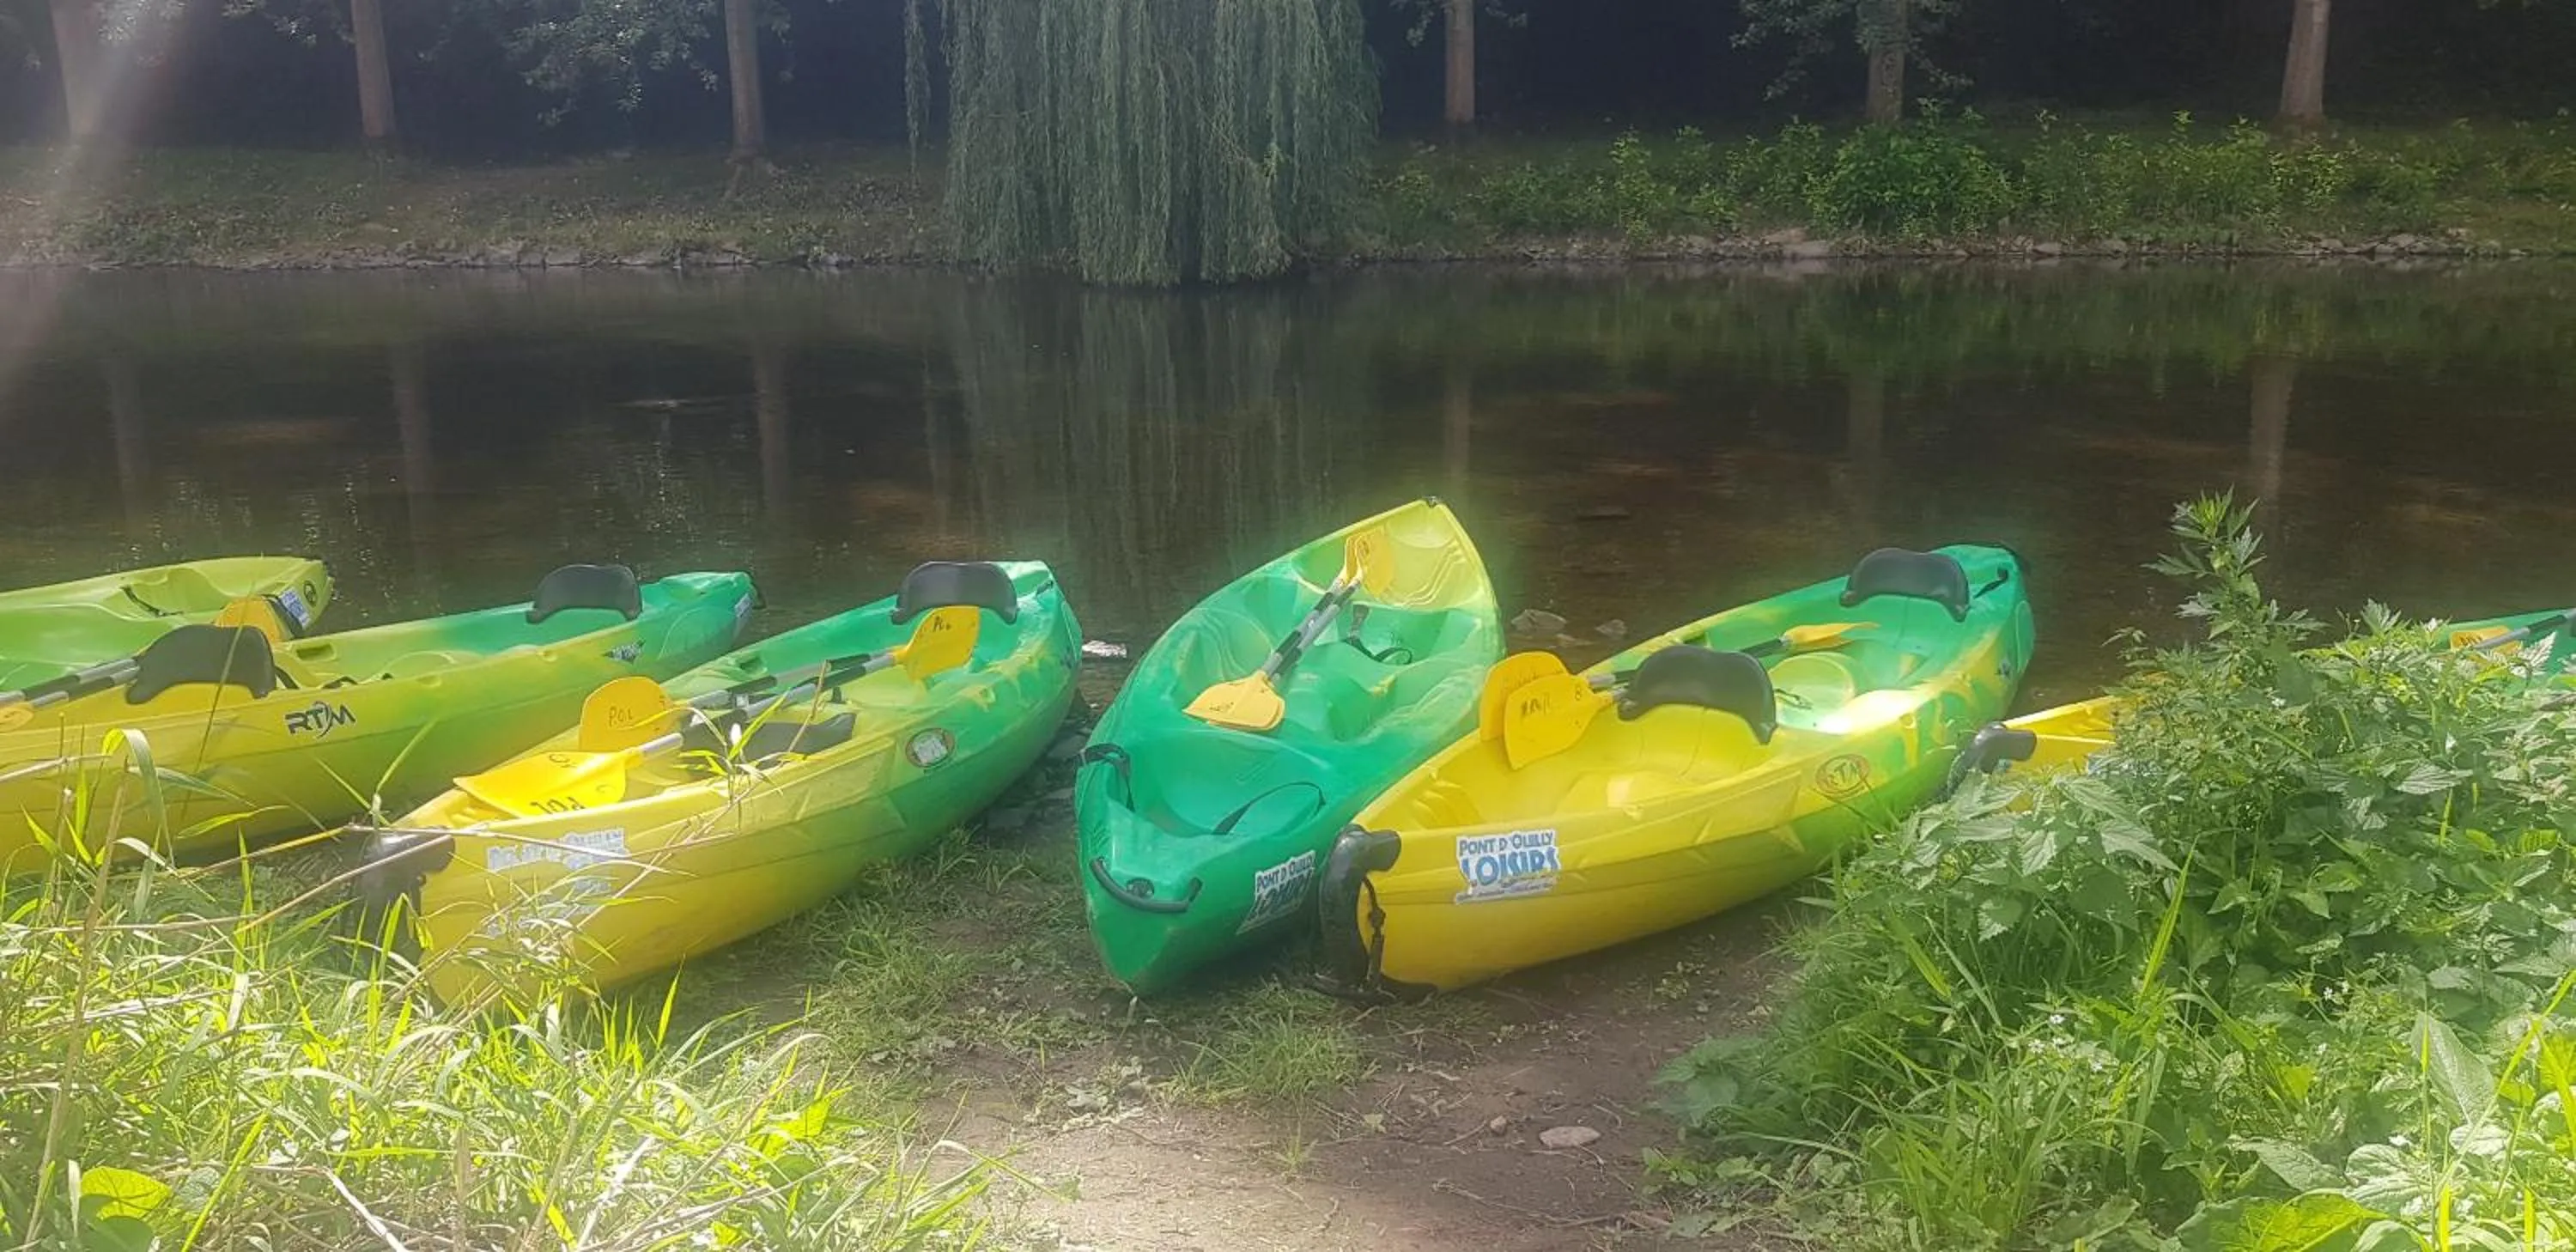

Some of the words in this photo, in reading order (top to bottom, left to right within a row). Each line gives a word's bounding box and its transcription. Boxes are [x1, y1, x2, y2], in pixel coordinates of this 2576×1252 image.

[284, 701, 356, 738] RTM
[1460, 838, 1496, 857] PONT
[1461, 846, 1558, 886] LOISIRS
[1256, 870, 1279, 894] PONT
